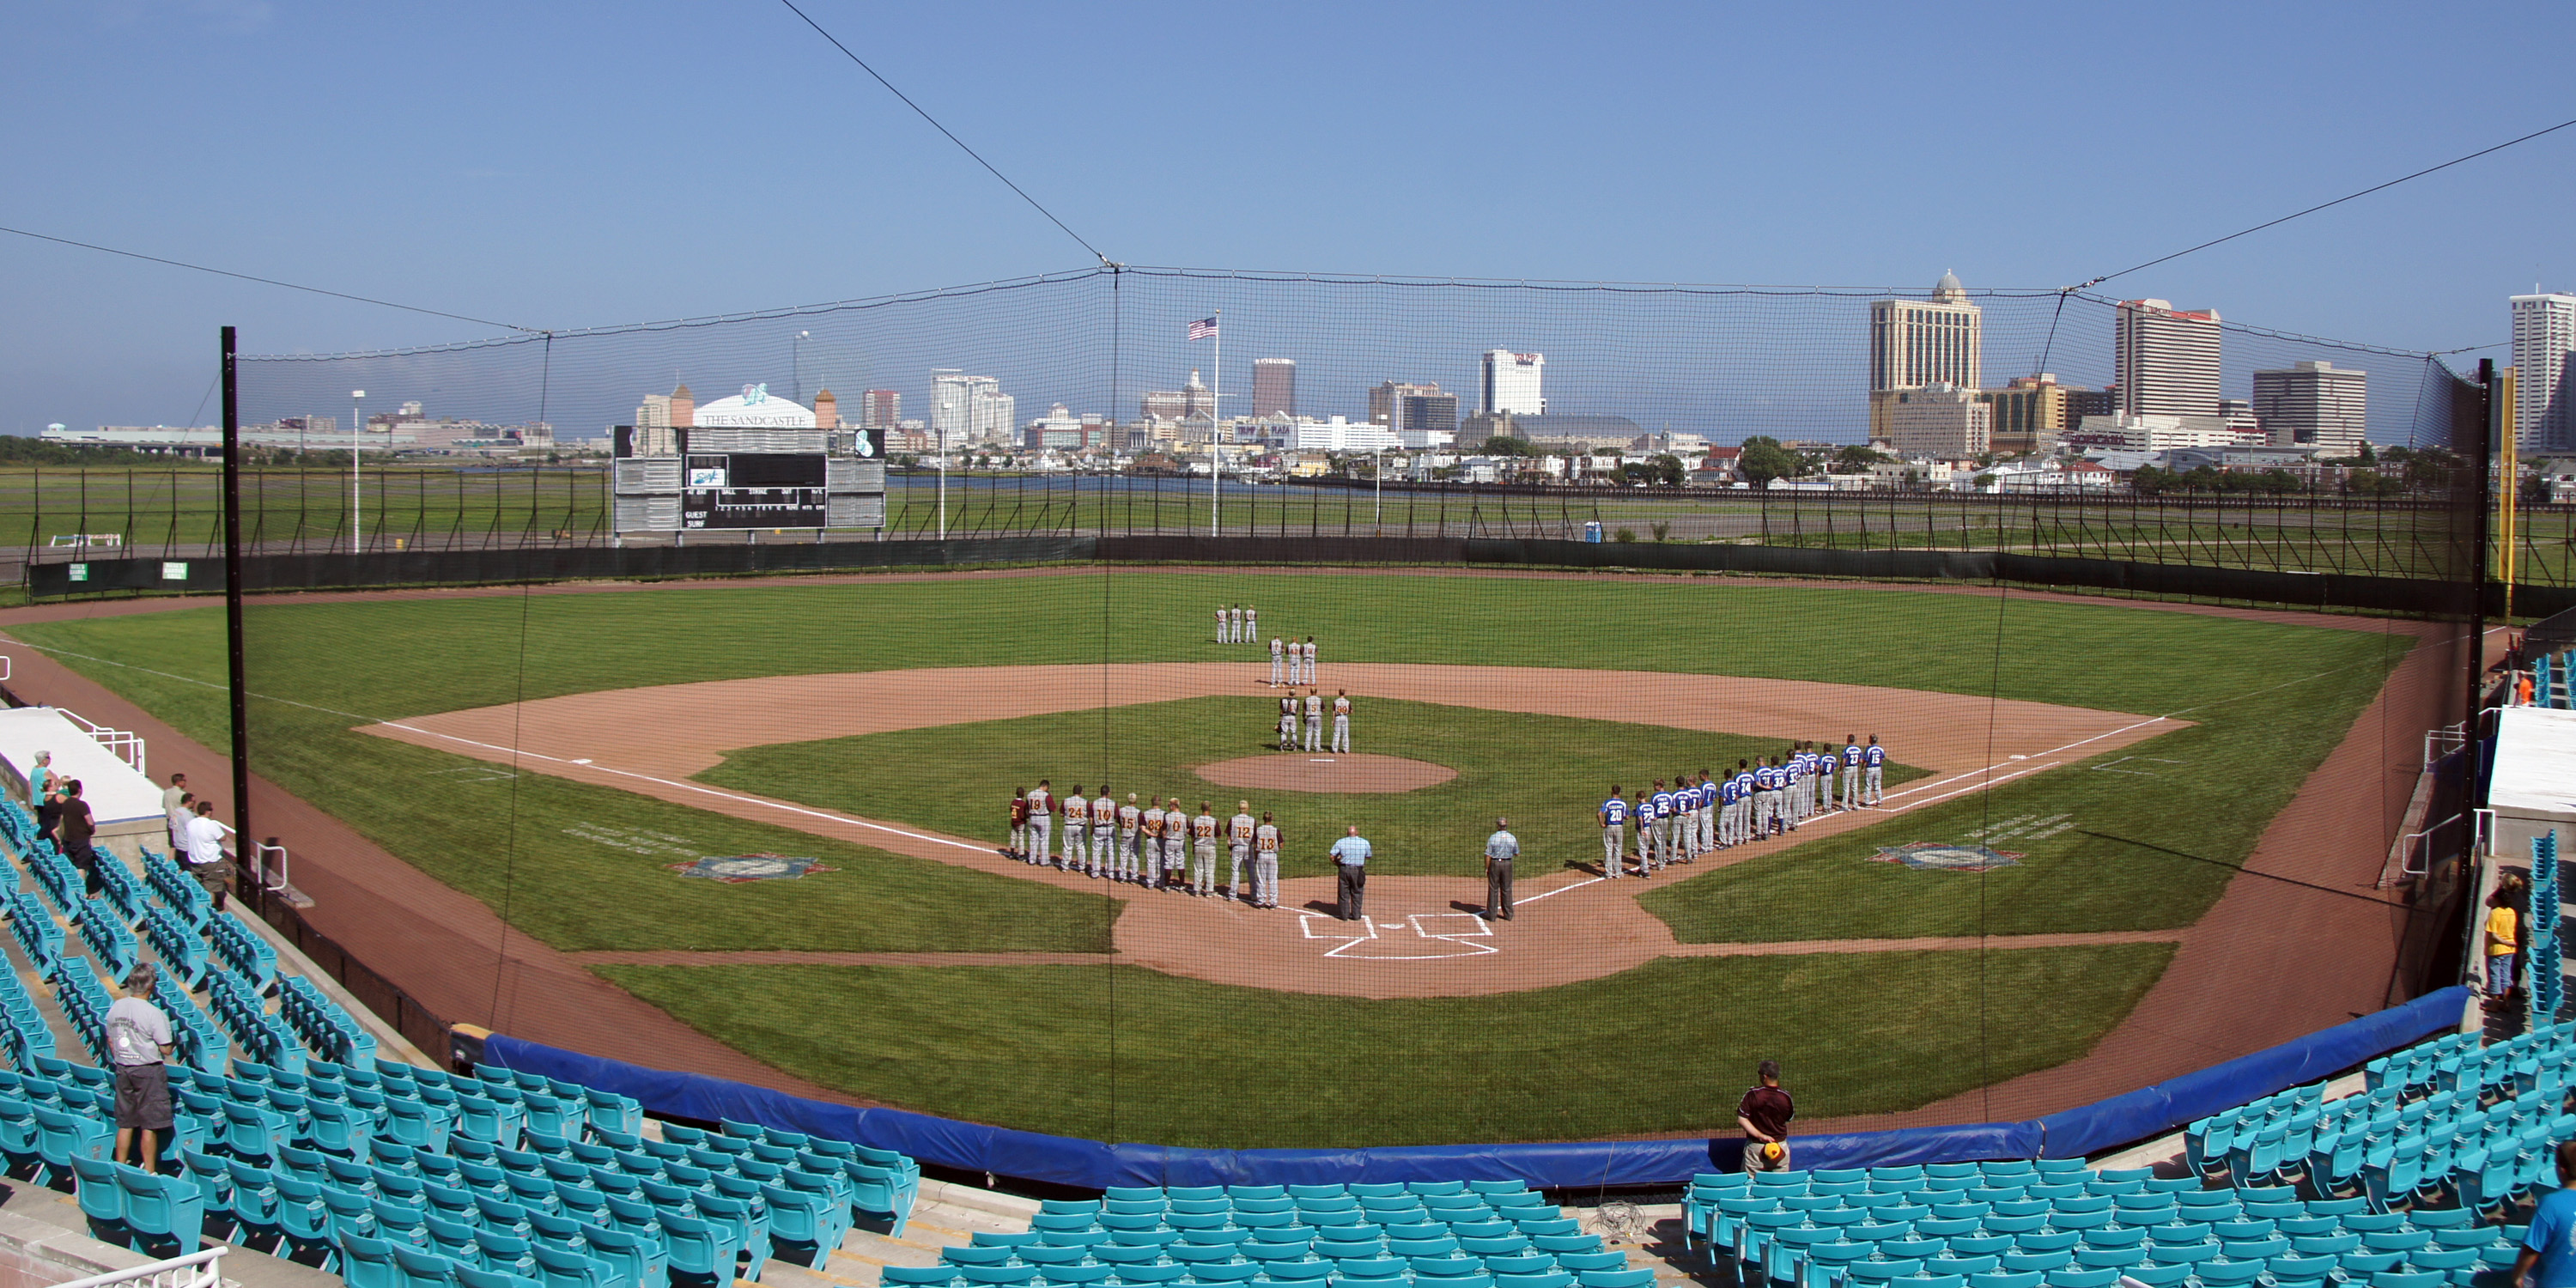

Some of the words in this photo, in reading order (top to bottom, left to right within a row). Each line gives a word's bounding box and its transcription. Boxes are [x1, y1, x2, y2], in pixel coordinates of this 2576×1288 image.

[704, 415, 728, 425] THE
[731, 416, 806, 426] SANDCASTLE
[1030, 799, 1041, 810] 19
[1657, 802, 1669, 814] 25
[1680, 799, 1686, 811] 6
[1068, 807, 1082, 818] 24
[1097, 809, 1111, 820] 10
[1610, 810, 1622, 822] 20
[1121, 817, 1134, 829] 15
[1197, 825, 1212, 837] 22
[1237, 826, 1250, 838] 12
